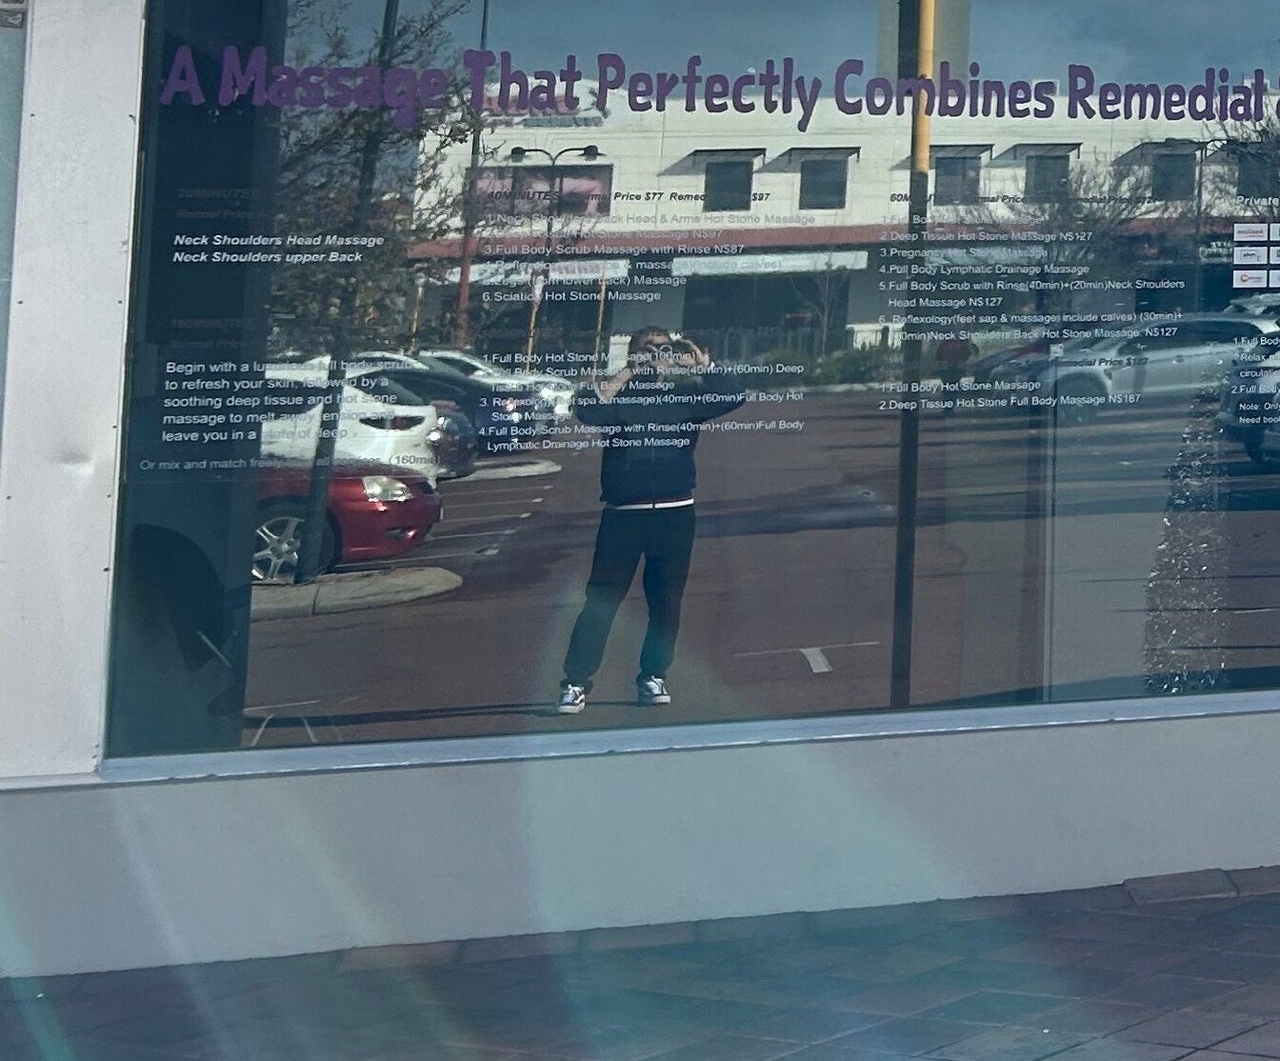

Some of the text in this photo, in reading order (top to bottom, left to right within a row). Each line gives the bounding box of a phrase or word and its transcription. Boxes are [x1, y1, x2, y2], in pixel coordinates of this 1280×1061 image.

[160, 45, 204, 107] A
[218, 45, 449, 130] Massage
[462, 49, 582, 113] That
[597, 53, 822, 132] Perfectly
[835, 59, 1055, 119] Combines
[1068, 63, 1265, 122] Remedial
[1236, 195, 1279, 206] Private
[174, 235, 384, 247] Neck Shoulders Head Massage
[521, 245, 551, 256] Body
[556, 245, 590, 255] Scrub
[594, 245, 648, 256] Massage
[651, 245, 674, 254] with
[678, 244, 711, 254] Rinse
[172, 252, 363, 264] Neck Shoulders upper Back
[166, 362, 249, 374] Begin with a
[165, 380, 177, 390] to
[181, 379, 230, 389] refresh
[233, 380, 264, 392] your
[163, 394, 332, 409] soothing deep tissue and
[920, 400, 953, 409] Tissue
[956, 399, 975, 408] Hot
[977, 398, 1008, 408] Stone
[1010, 397, 1029, 406] Full
[1032, 396, 1058, 408] Body
[1061, 395, 1106, 407] Massage
[163, 413, 242, 426] massage to
[511, 426, 538, 438] Body
[541, 425, 572, 436] Scrub
[574, 424, 621, 436] Massage
[624, 424, 645, 433] with
[779, 421, 805, 432] Body
[162, 430, 199, 442] leave
[202, 431, 228, 444] you
[231, 430, 244, 441] in
[247, 432, 256, 441] a
[487, 437, 690, 451] Lymphatic Drainage Hot Stone Massage
[140, 457, 247, 469] Or mix and match
